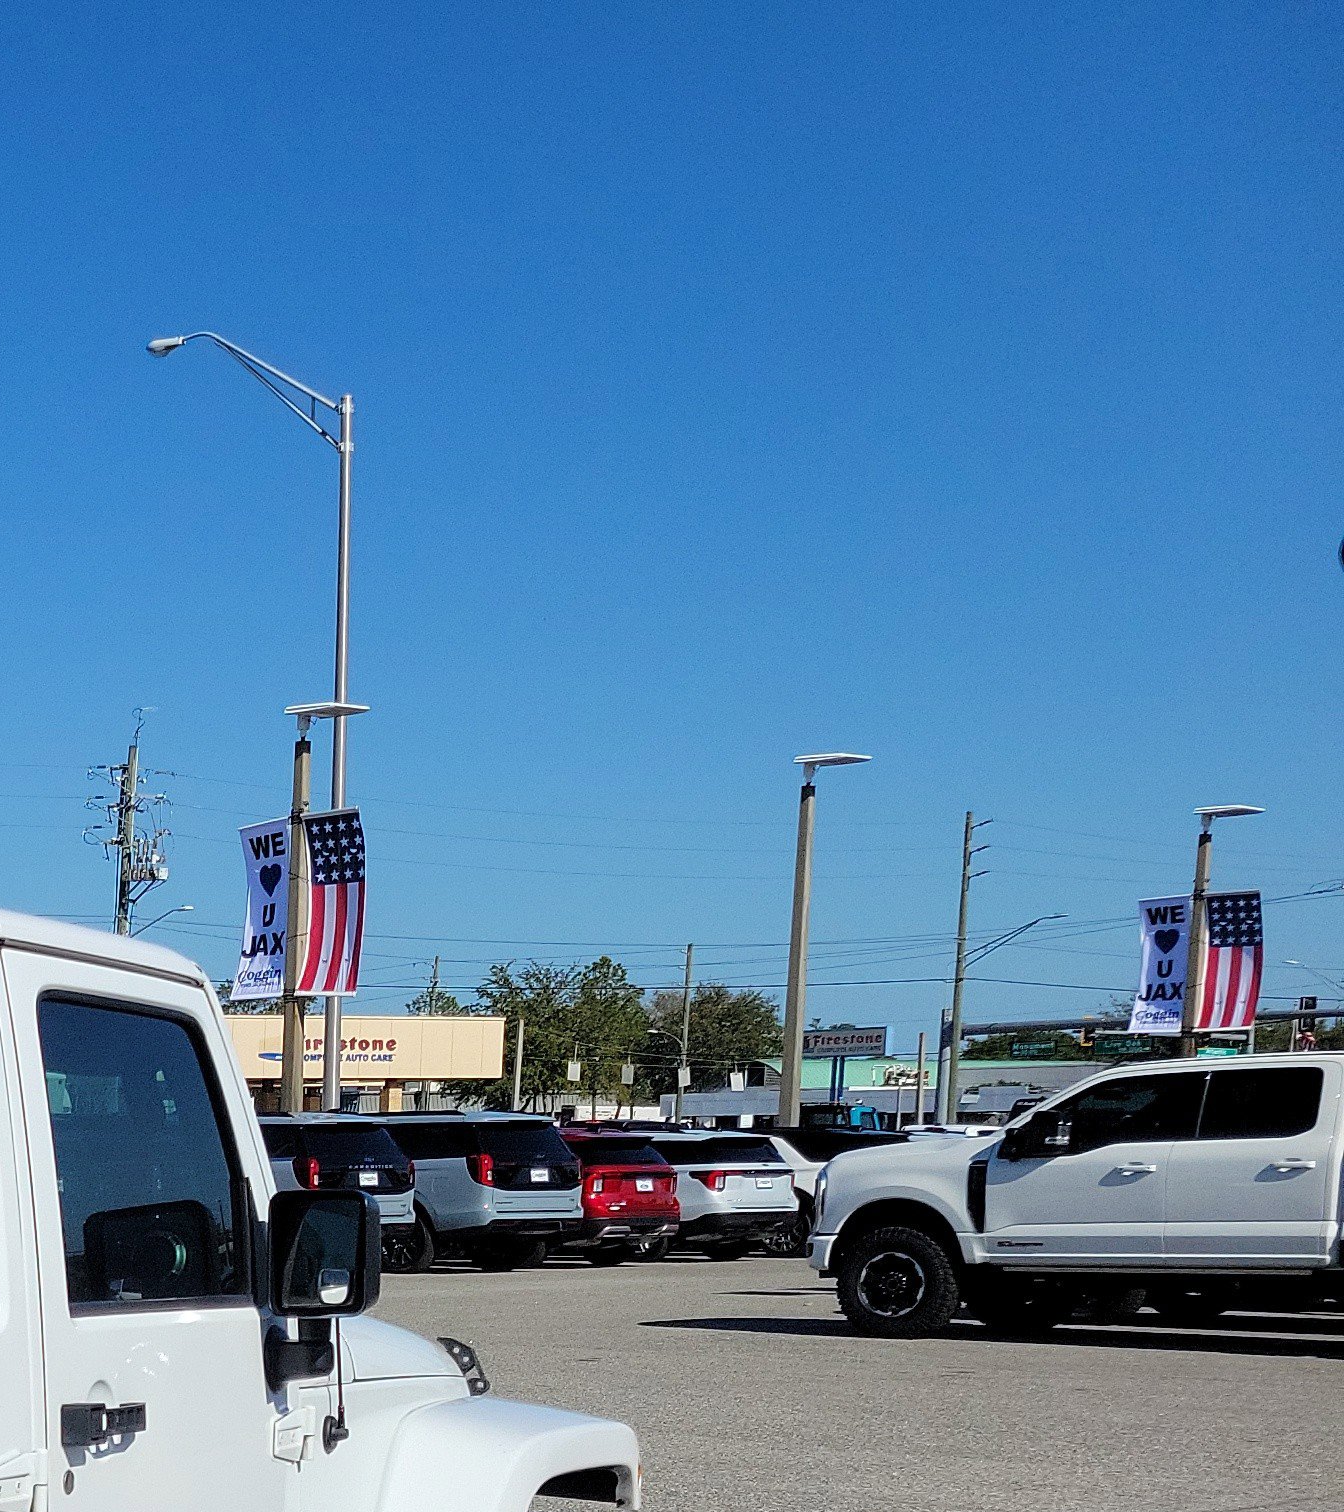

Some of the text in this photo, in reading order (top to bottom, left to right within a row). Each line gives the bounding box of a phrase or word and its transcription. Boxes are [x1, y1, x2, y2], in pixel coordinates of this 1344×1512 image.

[248, 831, 286, 861] WE
[262, 902, 276, 928] U
[1146, 904, 1186, 926] WE
[241, 930, 286, 959] JAX
[1156, 959, 1174, 979] U
[1137, 981, 1185, 1002] JAX
[1135, 1008, 1180, 1021] Coggin
[813, 1034, 883, 1047] Firestone
[345, 1053, 369, 1062] AUTO
[370, 1053, 394, 1062] CARE
